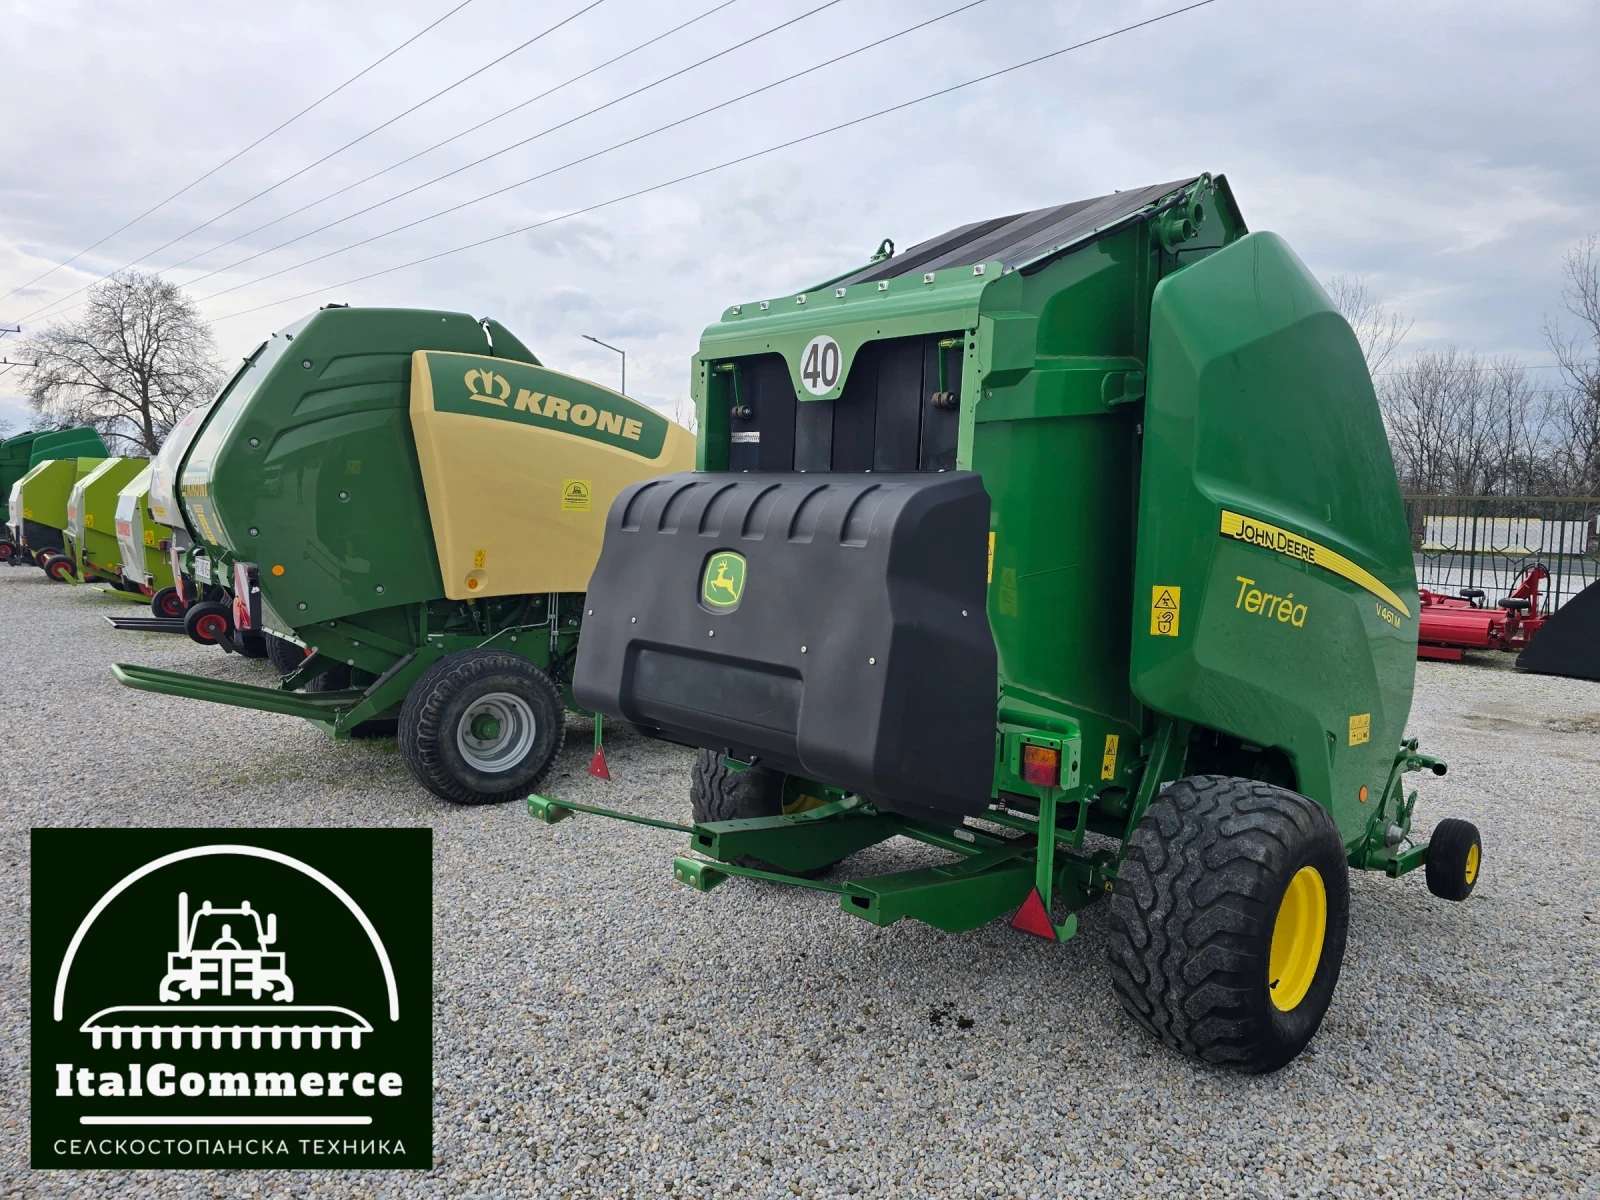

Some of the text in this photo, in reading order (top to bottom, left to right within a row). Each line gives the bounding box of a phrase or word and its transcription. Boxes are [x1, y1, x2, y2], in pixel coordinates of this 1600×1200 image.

[803, 342, 839, 388] 40
[513, 388, 643, 441] KRONE
[1235, 520, 1316, 562] JOHN DEERE
[1235, 575, 1308, 628] Terréa
